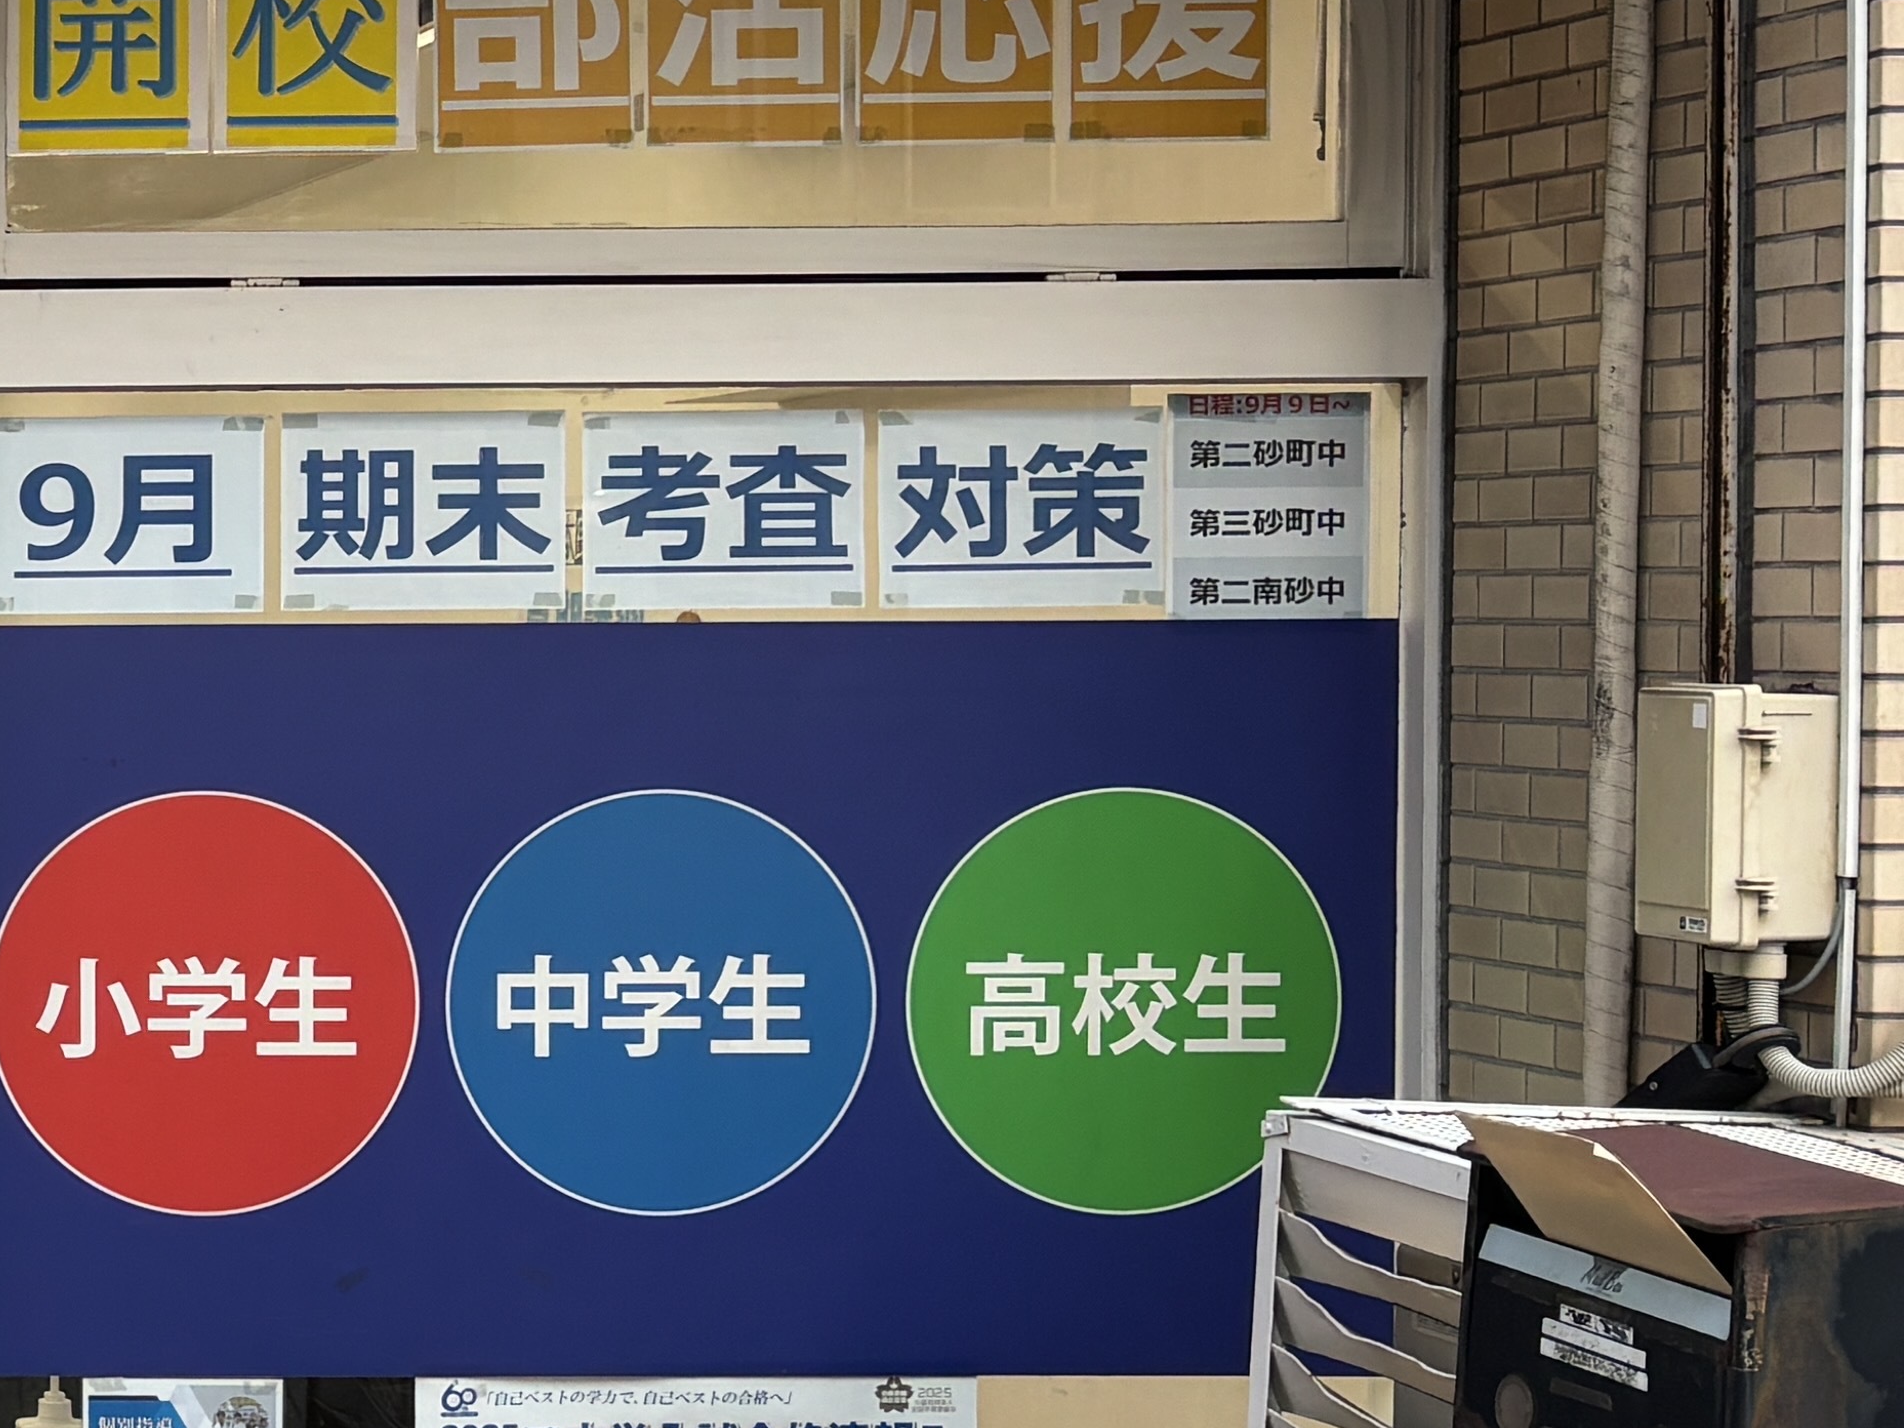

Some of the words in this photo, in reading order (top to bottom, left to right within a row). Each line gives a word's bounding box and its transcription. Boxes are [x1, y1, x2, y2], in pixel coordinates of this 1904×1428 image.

[1190, 439, 1346, 468] 第二砂町中
[1190, 508, 1345, 537] 第三砂町中
[1189, 576, 1345, 605] 第二南砂中
[36, 955, 359, 1060] 小学生
[495, 952, 811, 1059] 中学生
[965, 951, 1287, 1057] 高校生
